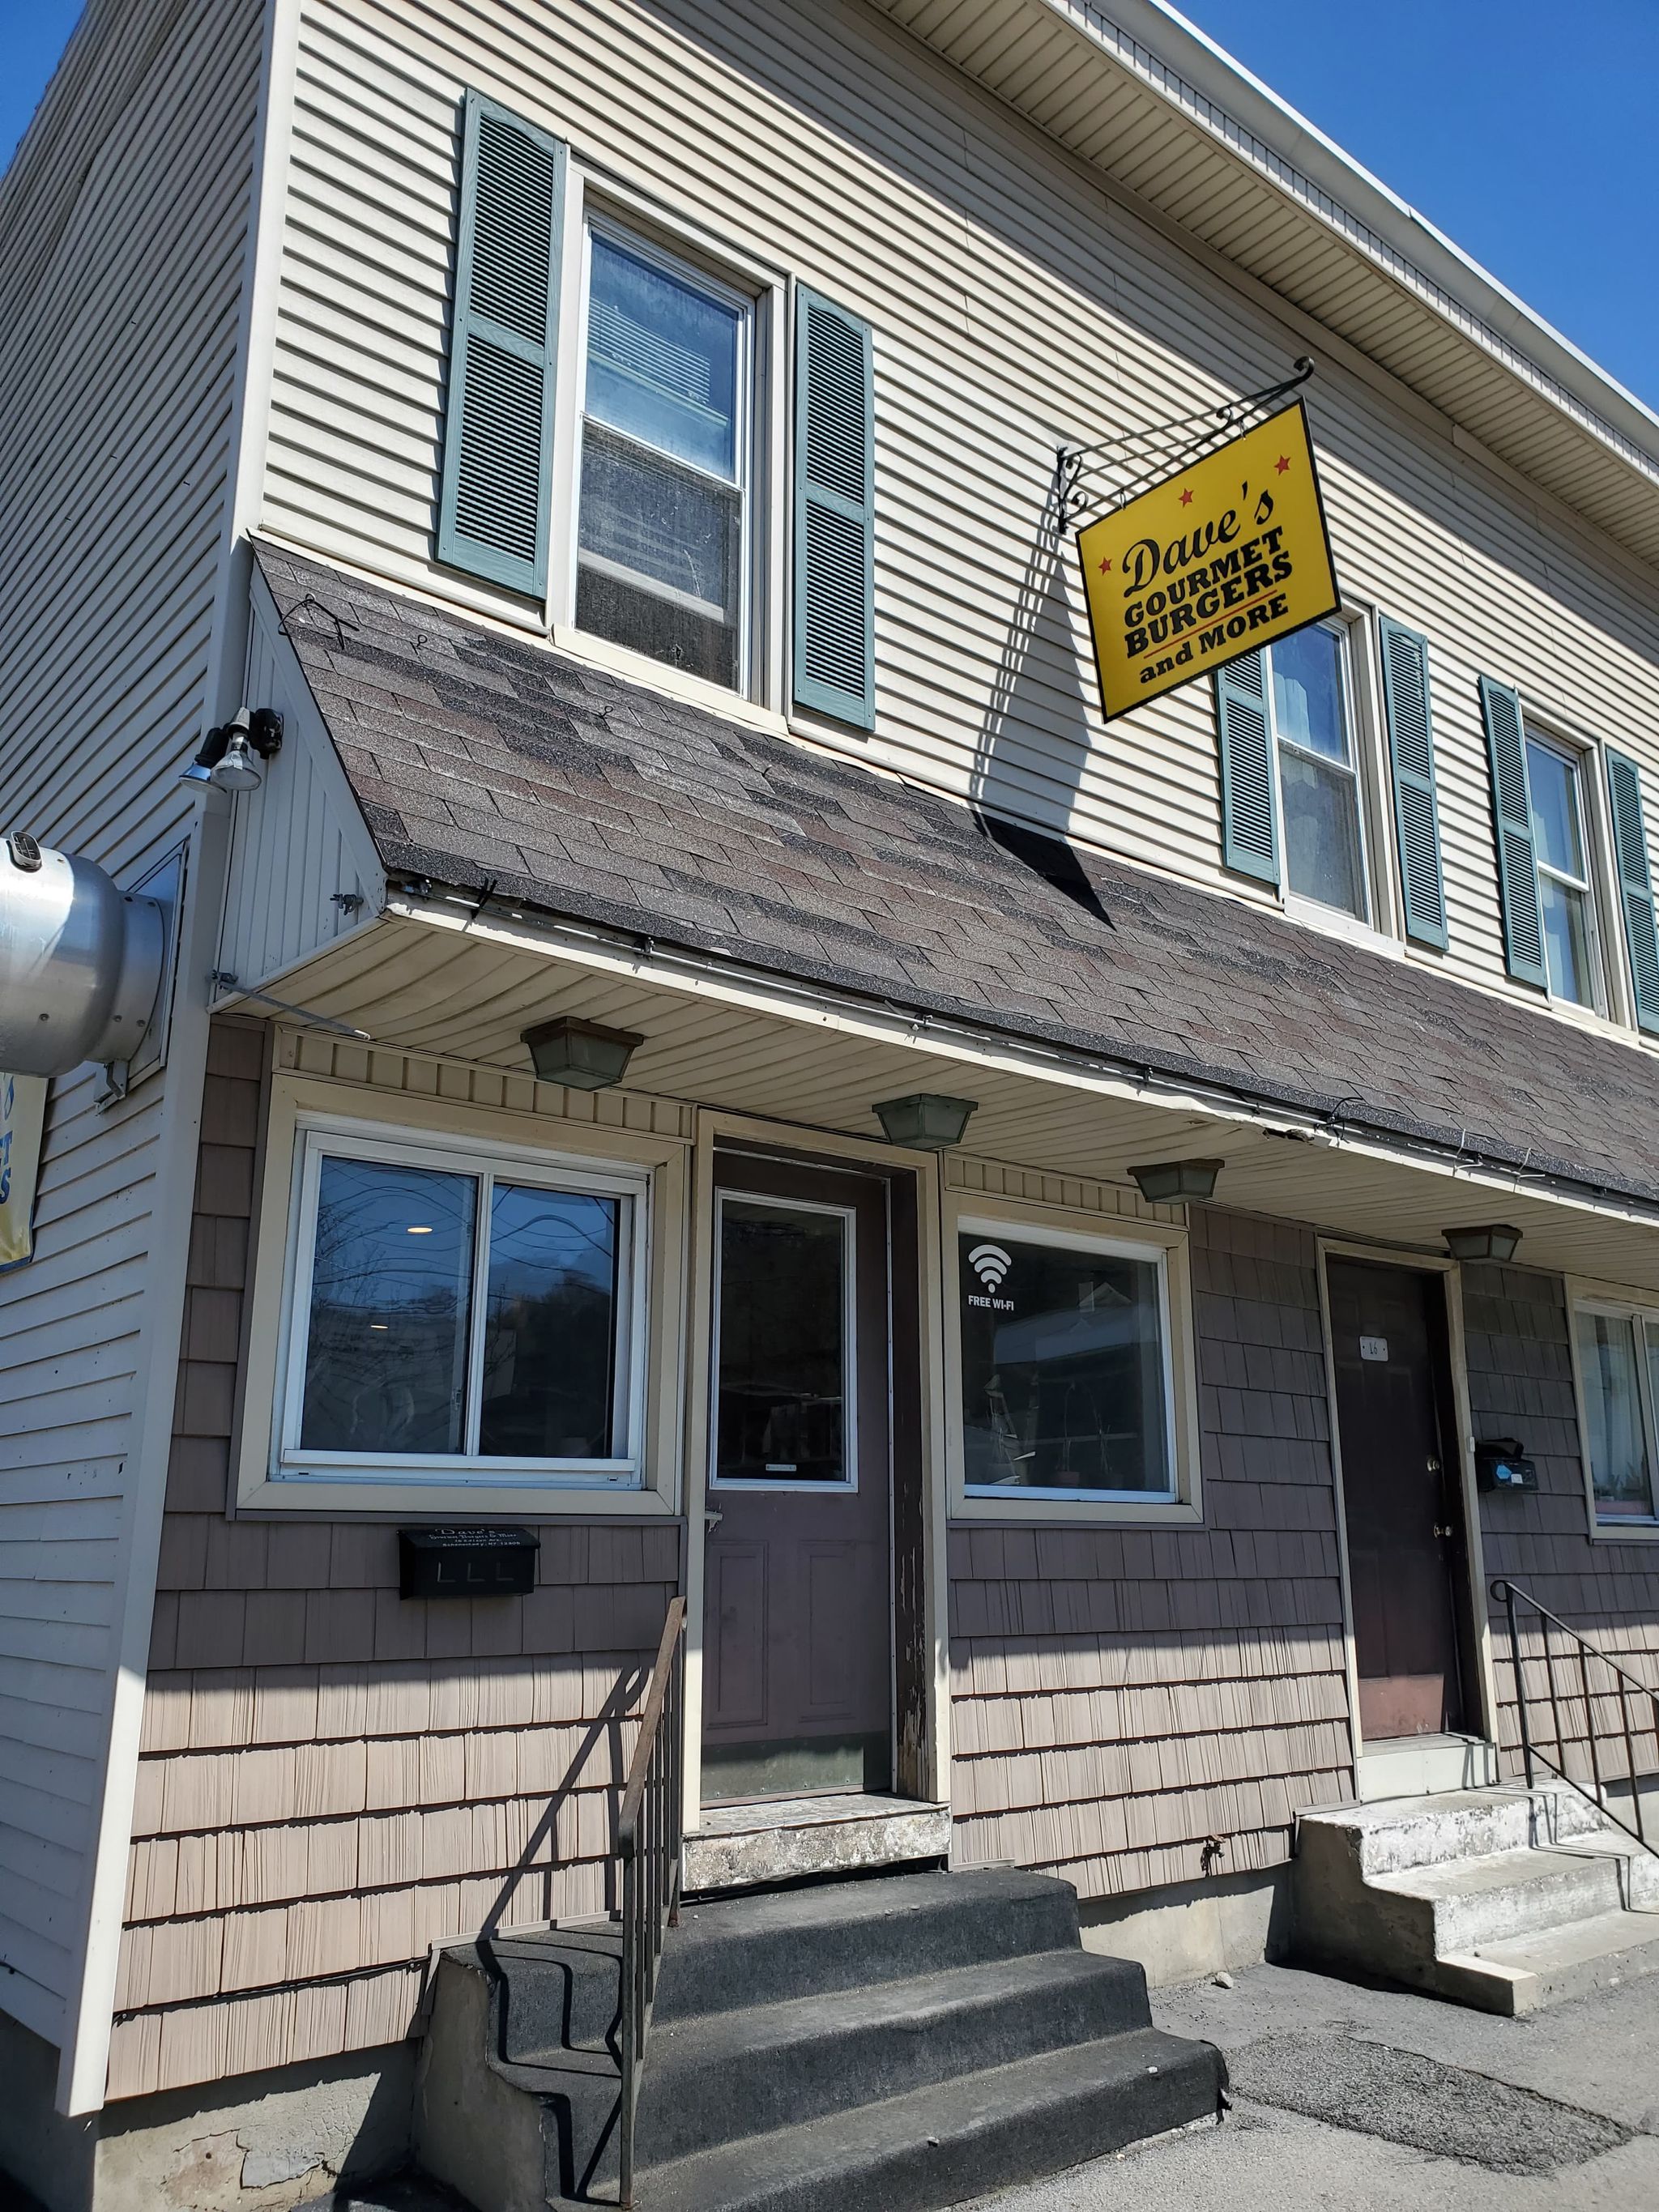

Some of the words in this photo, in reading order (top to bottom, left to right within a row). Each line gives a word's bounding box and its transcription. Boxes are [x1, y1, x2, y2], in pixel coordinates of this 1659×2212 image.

[1122, 480, 1274, 598] Dave's
[1124, 526, 1284, 628] GOURMET
[1124, 551, 1293, 659] BURGERS
[1139, 645, 1193, 684] and
[1198, 593, 1289, 655] MORE
[968, 1294, 992, 1308] FREE
[992, 1298, 1014, 1311] WI-FI
